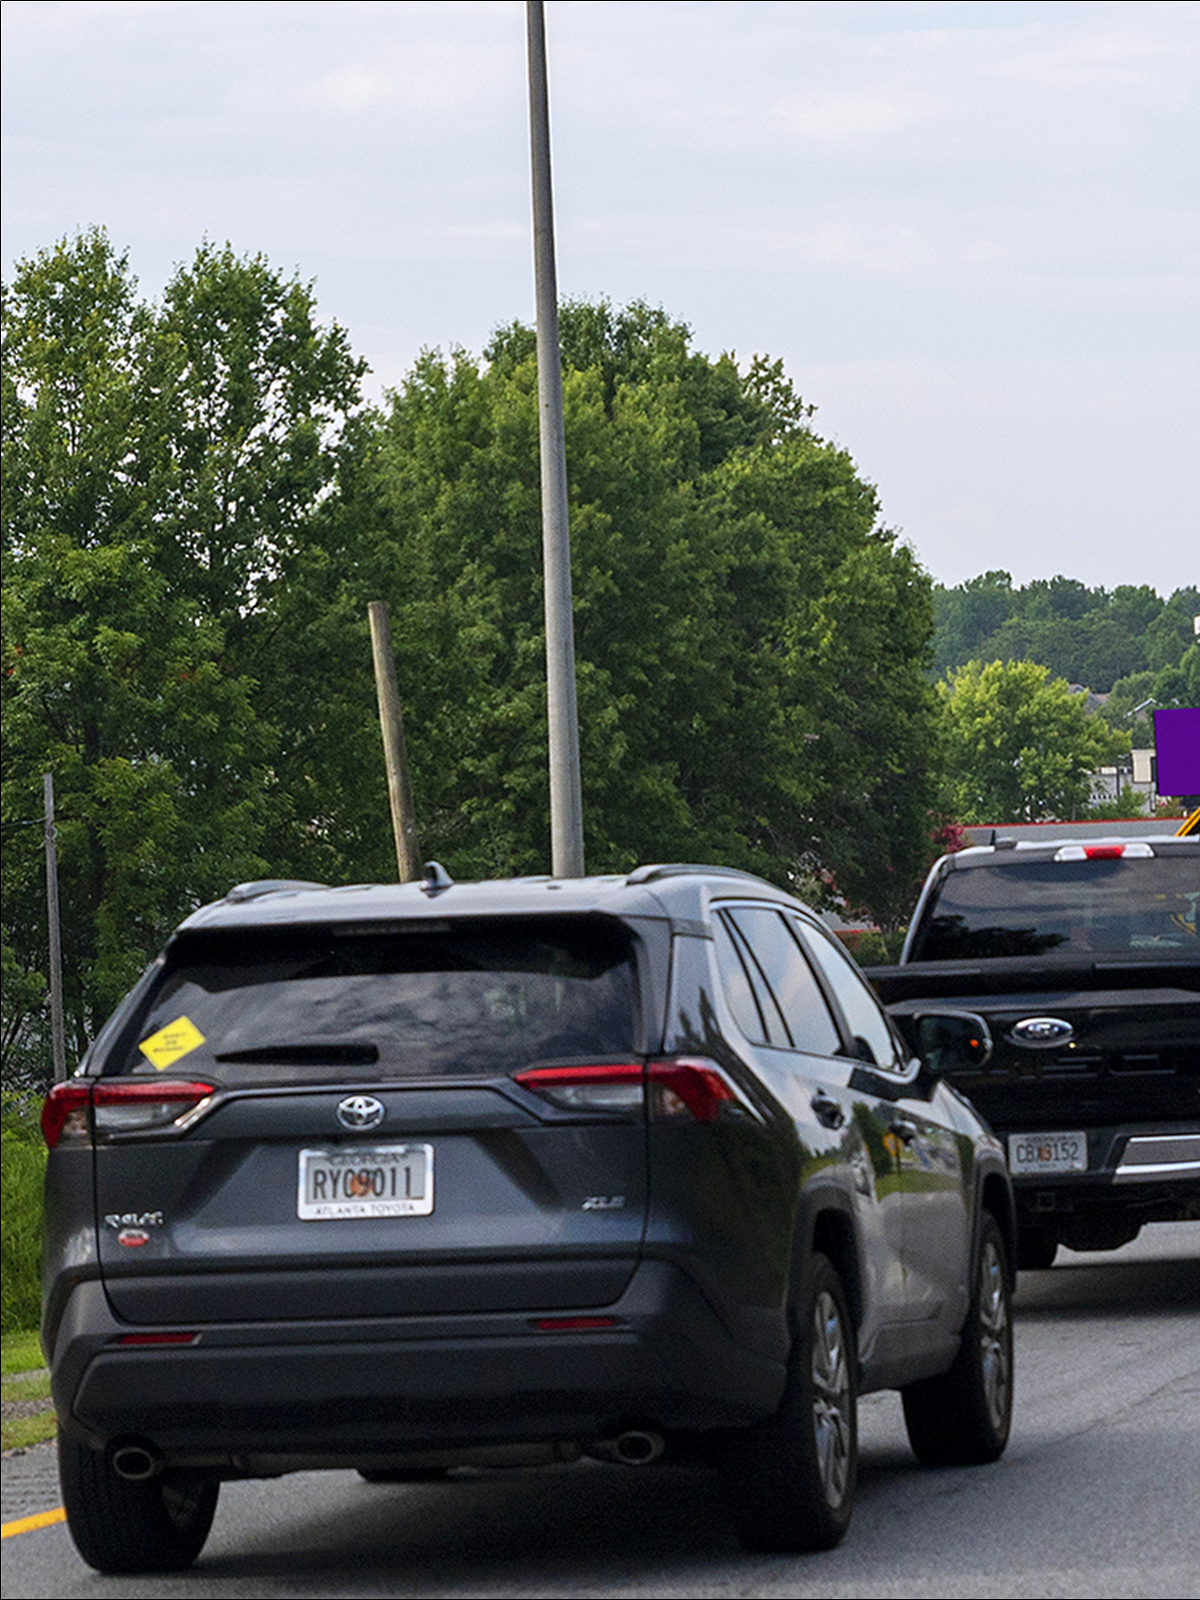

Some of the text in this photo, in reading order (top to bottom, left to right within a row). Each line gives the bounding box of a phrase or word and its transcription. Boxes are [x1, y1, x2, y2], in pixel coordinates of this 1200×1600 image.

[313, 1166, 411, 1200] RYC9011
[316, 1203, 415, 1214] ATLANTA TOYOTA
